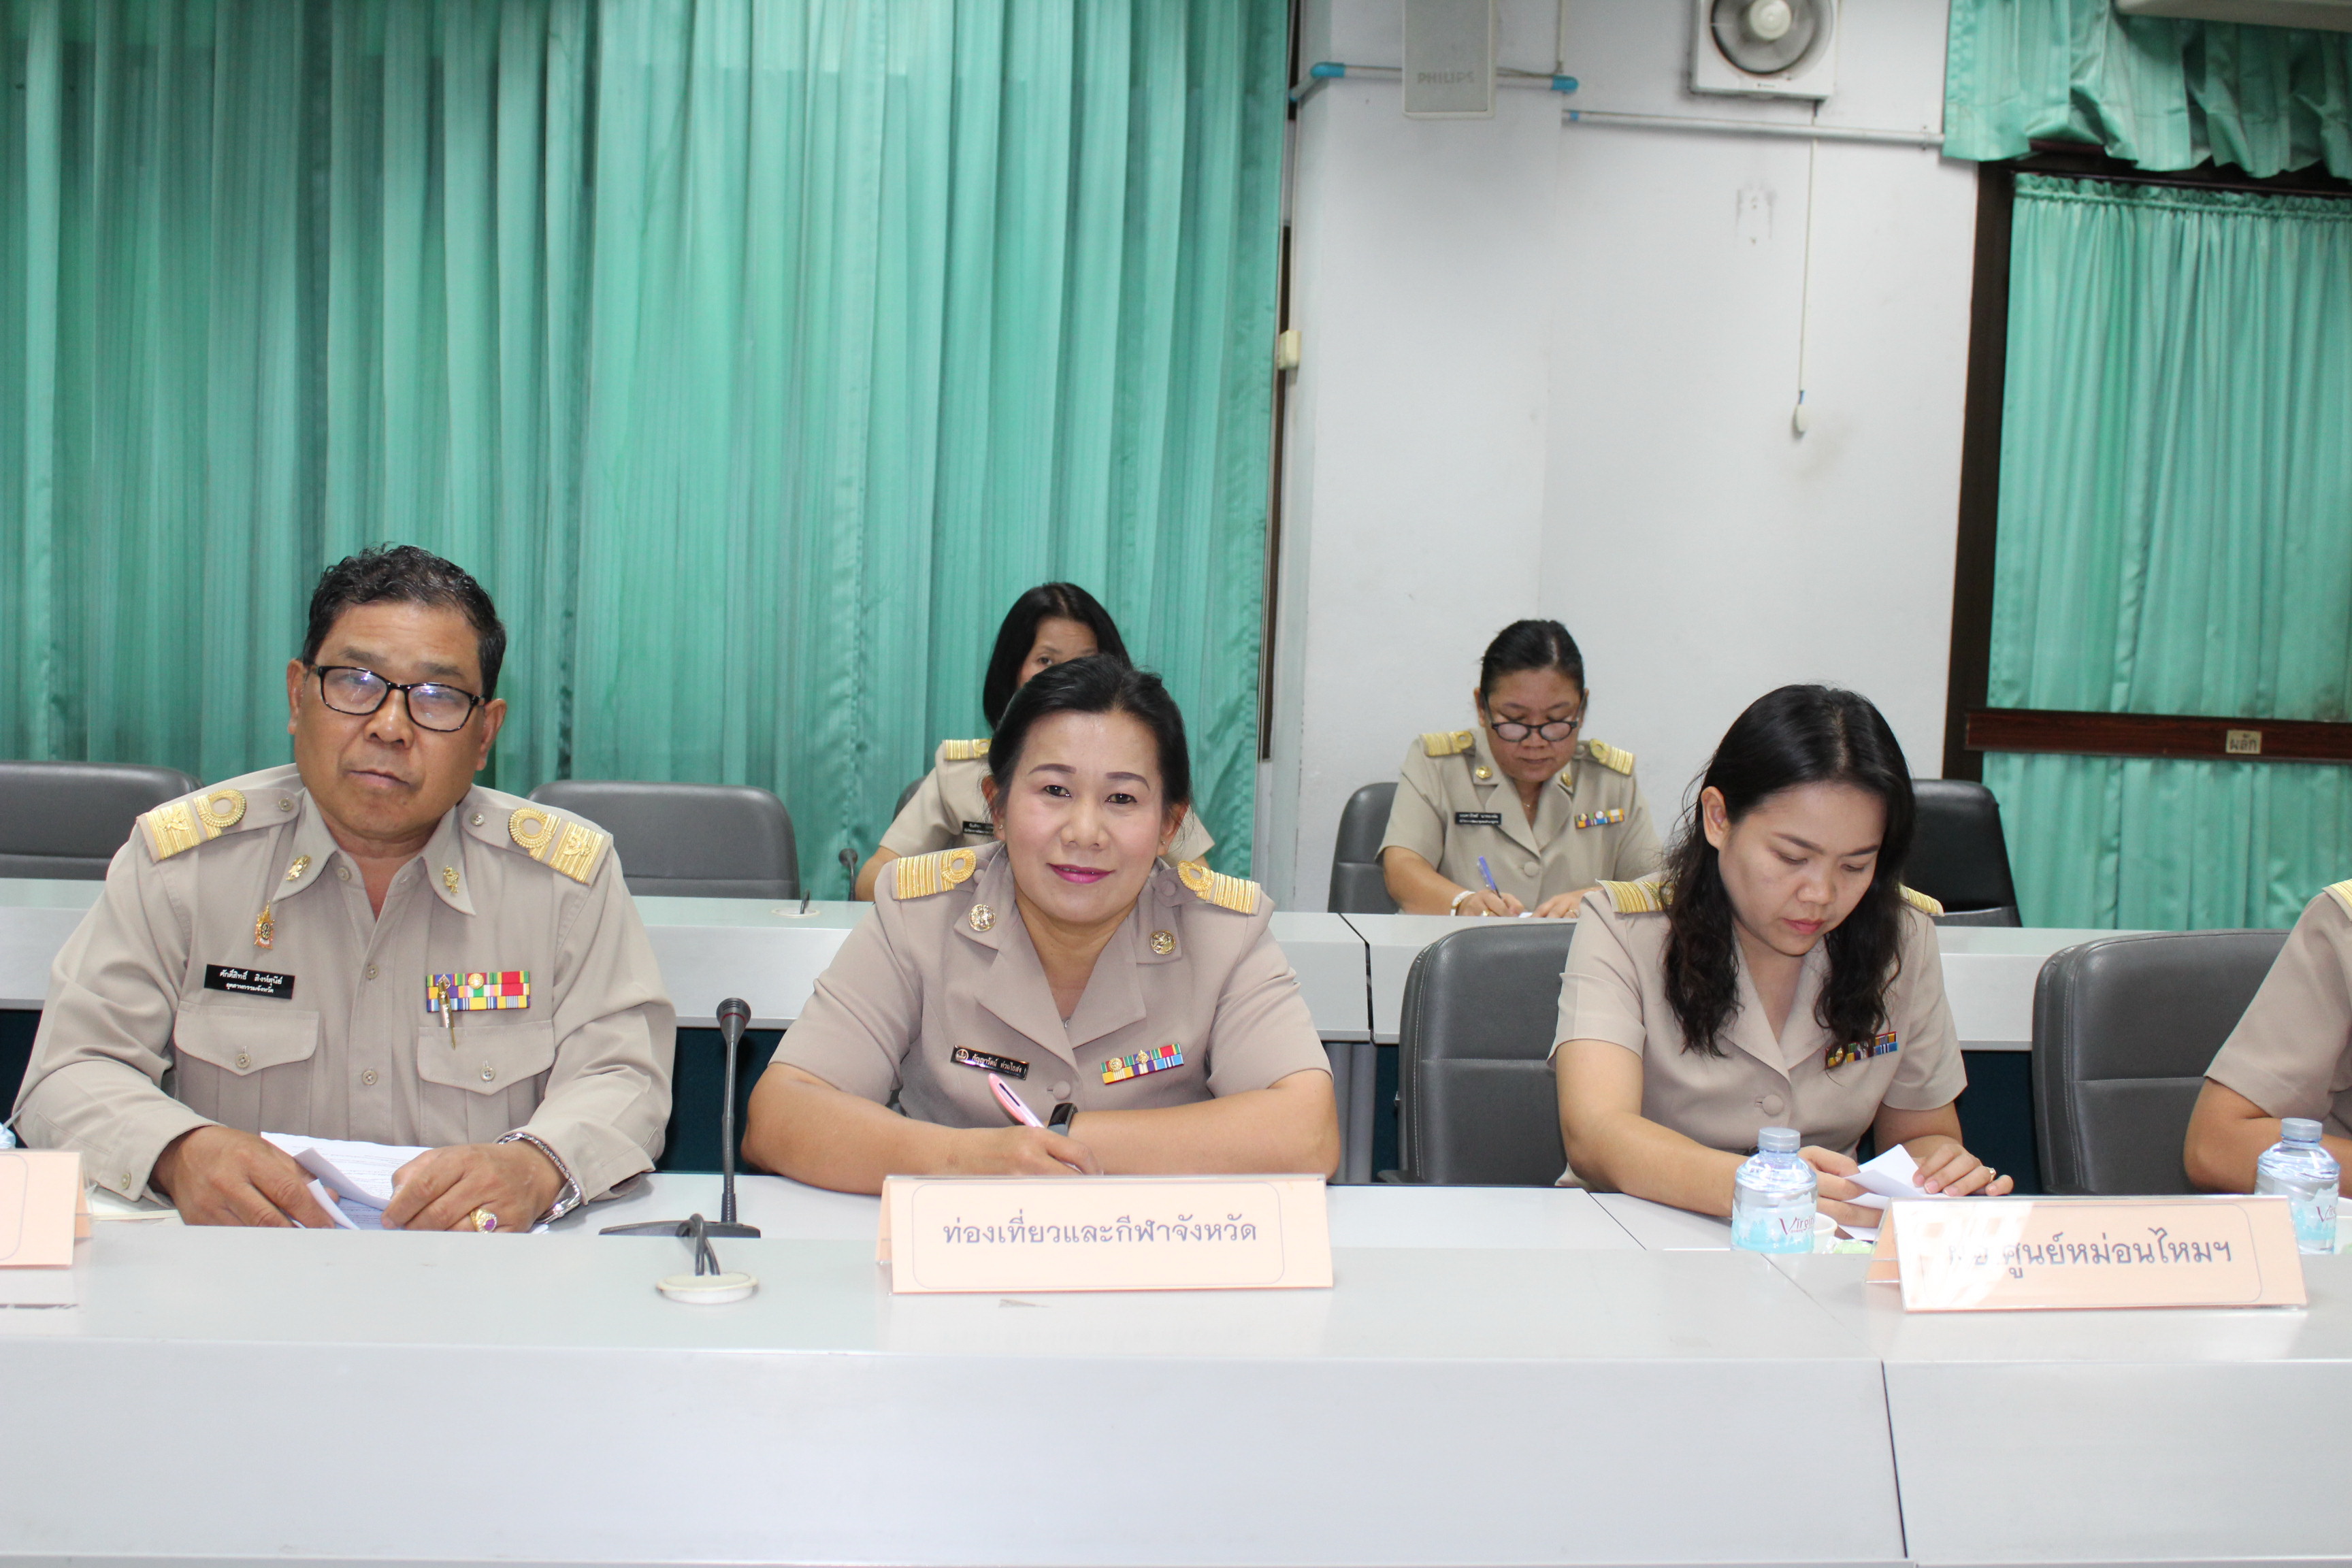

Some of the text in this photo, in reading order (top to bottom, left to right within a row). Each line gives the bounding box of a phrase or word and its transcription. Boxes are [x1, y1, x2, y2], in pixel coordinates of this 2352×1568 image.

[1418, 71, 1475, 84] PHILIPS
[943, 1208, 1257, 1244] ท่องเที่ยวและกีฬาจังหวัด
[1778, 1216, 1815, 1235] Virgin
[2003, 1227, 2232, 1278] ศูนย์หม่อนไหมฯ
